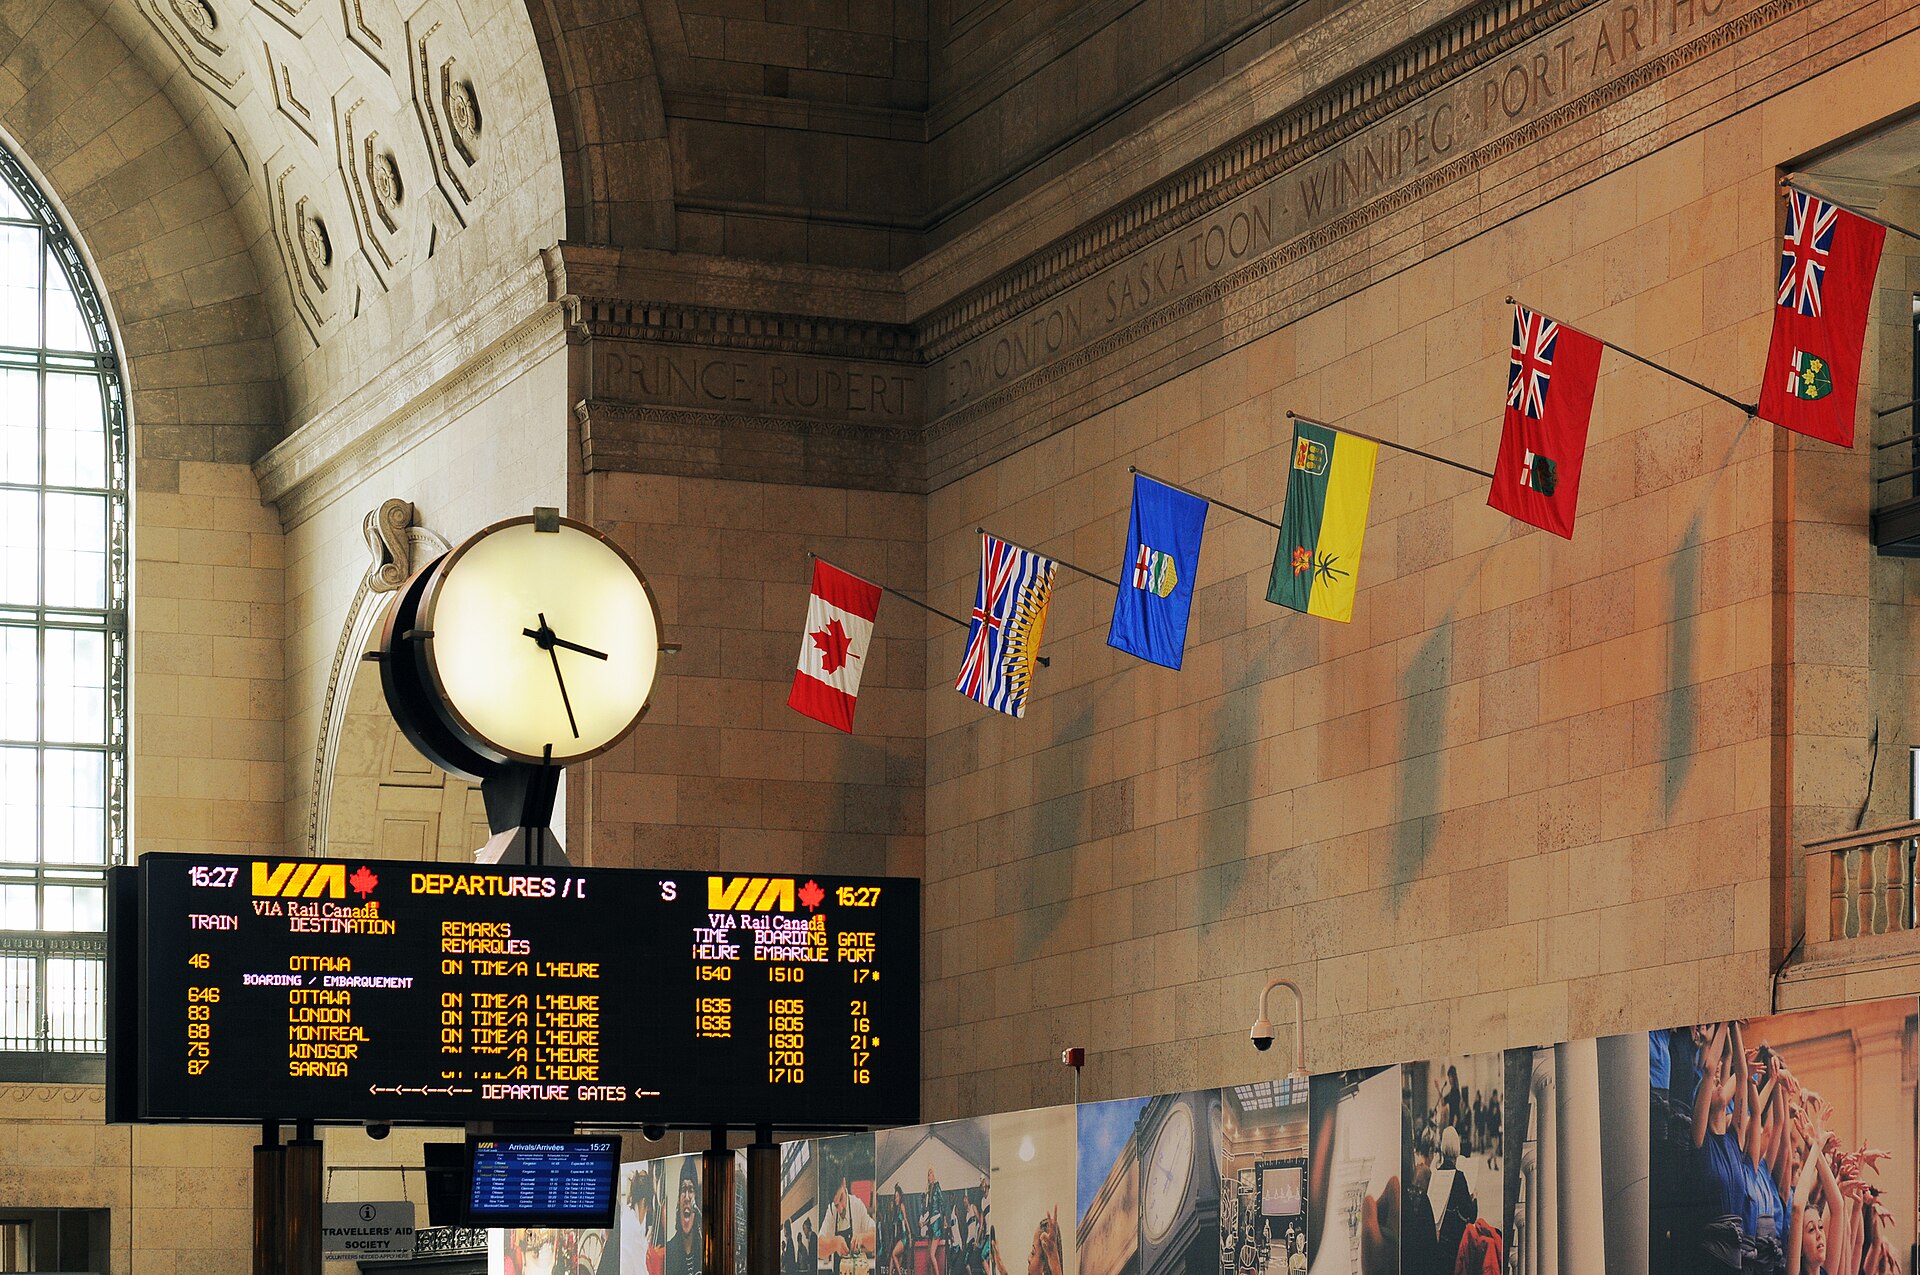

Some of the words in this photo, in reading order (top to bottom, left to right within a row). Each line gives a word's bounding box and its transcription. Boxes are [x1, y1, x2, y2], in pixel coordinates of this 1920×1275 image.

[948, 299, 1083, 405] EDMONTON
[1106, 196, 1274, 323] SASKATOON
[1299, 102, 1455, 221] WINNIPEG
[604, 352, 752, 402] PRINCE
[769, 366, 915, 415] RUPERT
[188, 866, 238, 887] 15:27
[252, 862, 346, 899] VIA
[411, 874, 556, 898] DEPARTURES
[708, 877, 795, 912] VIA
[836, 887, 881, 907] 15:27
[252, 901, 283, 917] VIA
[288, 902, 319, 918] Rail
[323, 903, 379, 919] Canada
[188, 914, 238, 930] TRAIN
[290, 919, 395, 934] DESTINATION
[708, 914, 737, 929] VIA
[741, 914, 770, 930] Rail
[773, 915, 826, 931] Canada
[442, 922, 511, 938] REMARKS
[693, 928, 729, 943] TIME
[755, 931, 827, 946] BOARDING
[838, 932, 875, 947] GATE
[442, 938, 530, 955] REMARQUES
[693, 944, 740, 960] HEURE
[754, 946, 829, 962] EMBARQUE
[188, 954, 210, 968] 46
[838, 948, 875, 963] PORT
[290, 956, 350, 971] OTTAWA
[442, 960, 462, 975] ON
[471, 961, 528, 977] TIME/A
[536, 962, 599, 977] L'HEURE
[243, 974, 302, 986] BOARDING
[324, 976, 413, 988] EMBARQUEMENT
[696, 966, 731, 981] 1540
[770, 967, 804, 982] 1510
[188, 987, 220, 1002] 646
[290, 990, 350, 1005] OTTAWA
[442, 993, 462, 1008] ON
[471, 994, 528, 1010] TIME/A
[536, 995, 599, 1010] L'HEURE
[188, 1005, 210, 1020] 83
[696, 998, 731, 1013] 1635
[769, 1000, 804, 1014] 1605
[851, 1001, 866, 1015] 21
[290, 1008, 350, 1023] LONDON
[442, 1010, 462, 1025] ON
[471, 1011, 528, 1027] TIME/A
[536, 1012, 599, 1027] L'HEURE
[696, 1016, 731, 1030] 1635
[188, 1024, 210, 1038] 68
[770, 1017, 804, 1031] 1605
[854, 1018, 869, 1032] 16
[290, 1025, 370, 1041] MONTREAL
[442, 1028, 462, 1043] ON
[471, 1029, 528, 1045] TIME/A
[536, 1030, 599, 1045] L'HEURE
[770, 1034, 804, 1048] 1630
[188, 1042, 210, 1057] 75
[290, 1044, 358, 1059] WINDSOR
[536, 1048, 599, 1063] L'HEURE
[769, 1051, 804, 1066] 1700
[854, 1052, 869, 1066] 17
[188, 1060, 209, 1075] 87
[290, 1061, 348, 1077] SARNIA
[536, 1065, 599, 1080] L'HEURE
[770, 1068, 804, 1083] 1710
[854, 1069, 870, 1083] 16
[482, 1085, 569, 1100] DEPARTURE
[578, 1086, 626, 1101] GATES
[508, 1143, 565, 1152] Arrivals/Arrivées
[590, 1143, 611, 1151] 15:27
[322, 1227, 392, 1236] TRAVELLERS'
[395, 1227, 413, 1235] AID
[345, 1240, 390, 1249] SOCIETY
